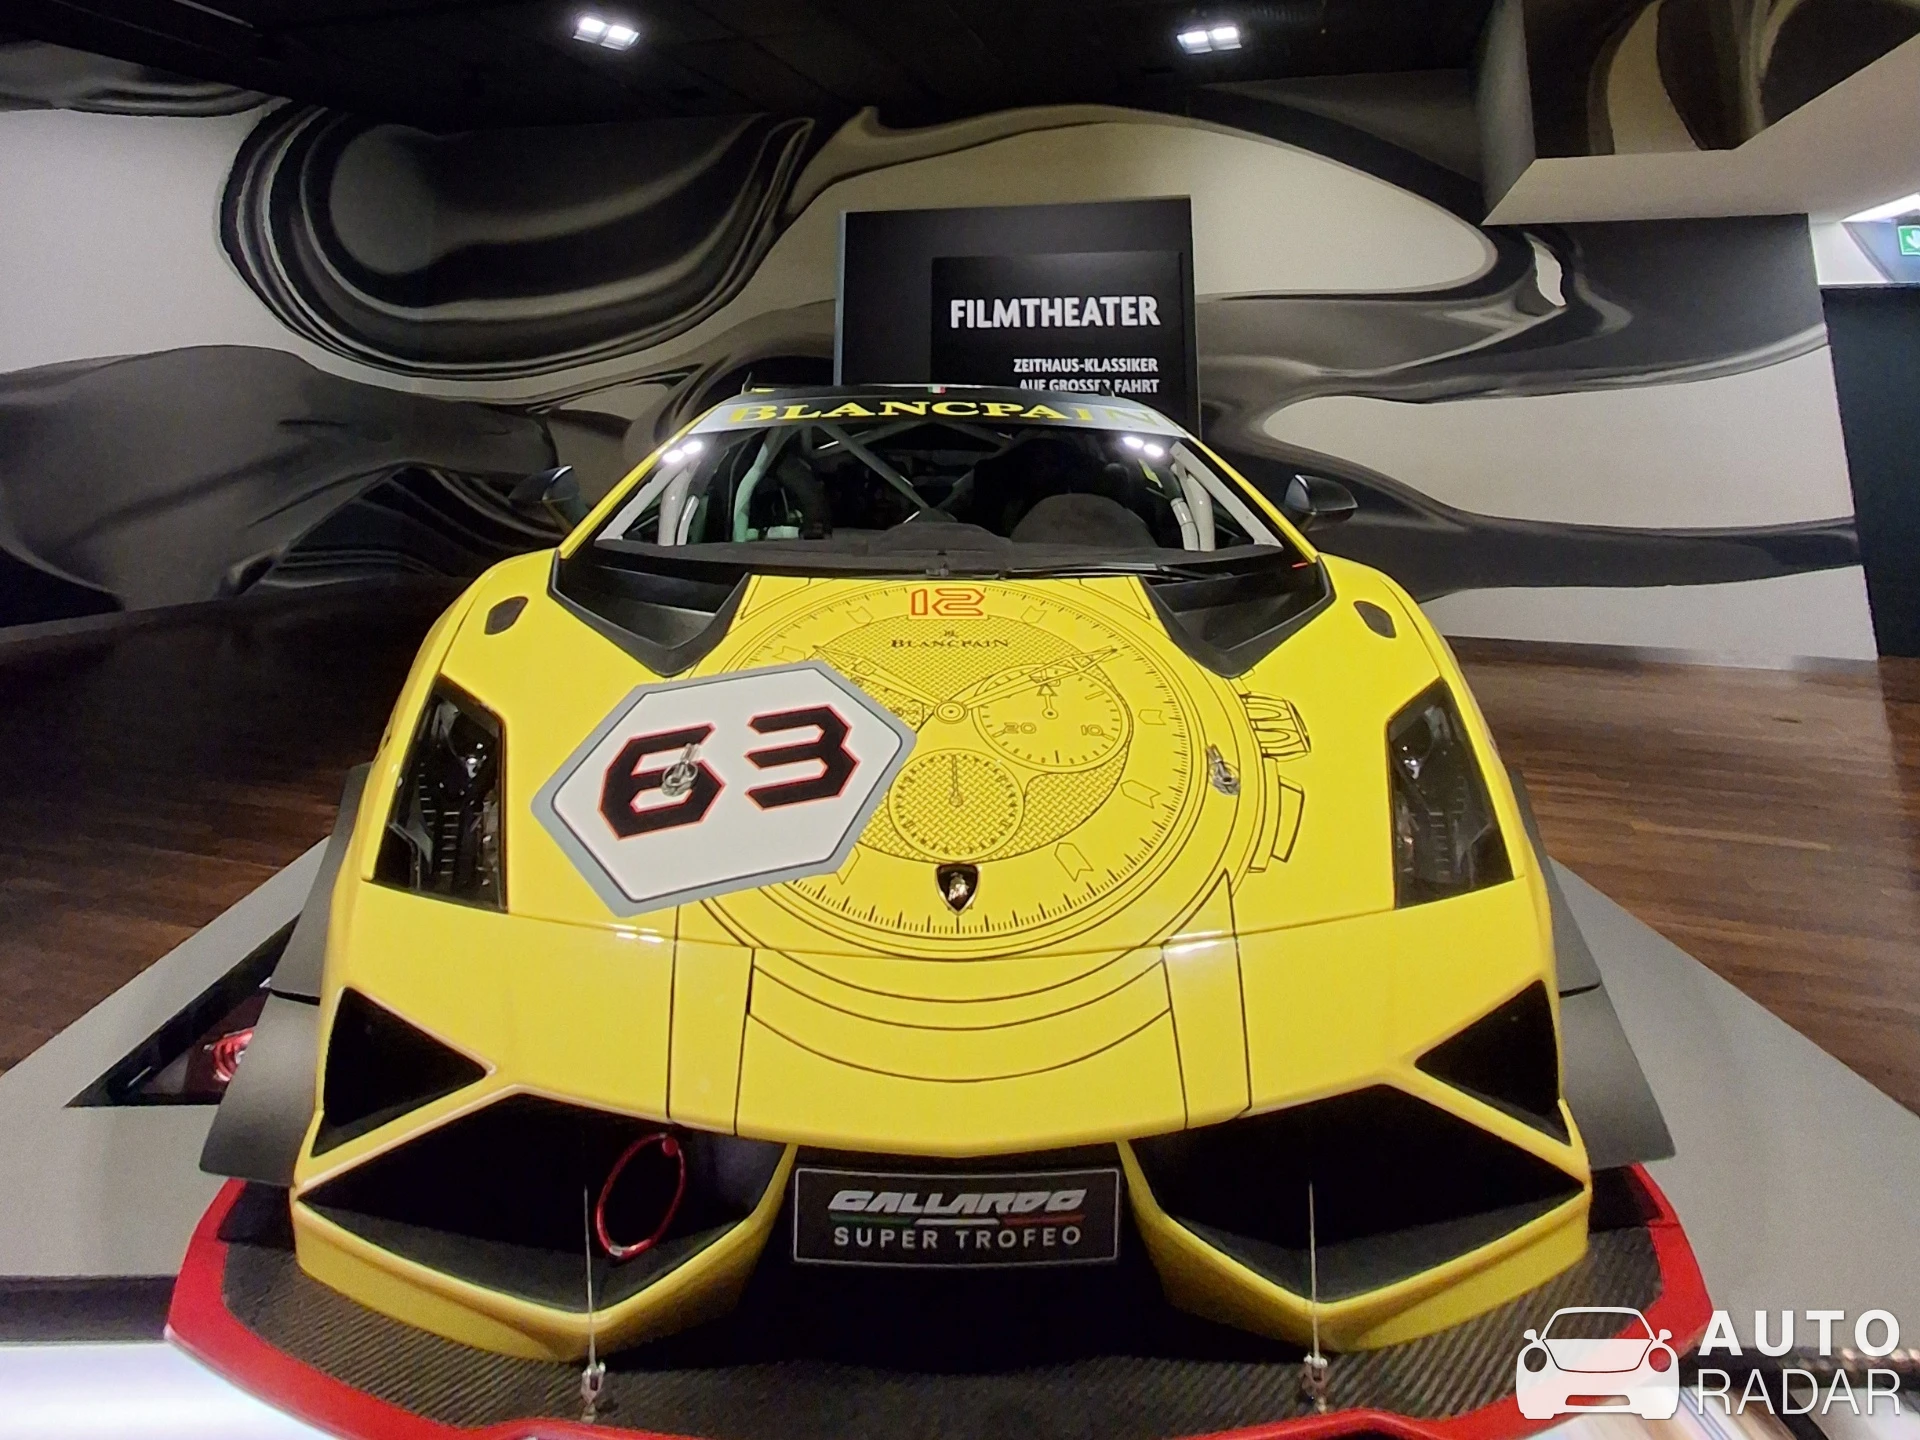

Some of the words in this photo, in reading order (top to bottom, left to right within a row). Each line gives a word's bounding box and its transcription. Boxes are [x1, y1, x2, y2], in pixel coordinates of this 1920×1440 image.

[950, 296, 1161, 328] FILMTHEATER
[1013, 357, 1159, 373] ZEITHAUS-KLASSIKER
[1019, 379, 1047, 390] AUF
[1114, 378, 1160, 393] FAHRT
[728, 400, 1158, 426] BLANCPAIN
[911, 587, 985, 616] 12
[891, 639, 1009, 648] BLANCPAIN
[1003, 721, 1037, 734] 20
[597, 703, 861, 841] 63
[827, 1188, 1088, 1215] GALLARDO
[833, 1225, 939, 1249] SUPER
[954, 1225, 1082, 1249] TROFEO
